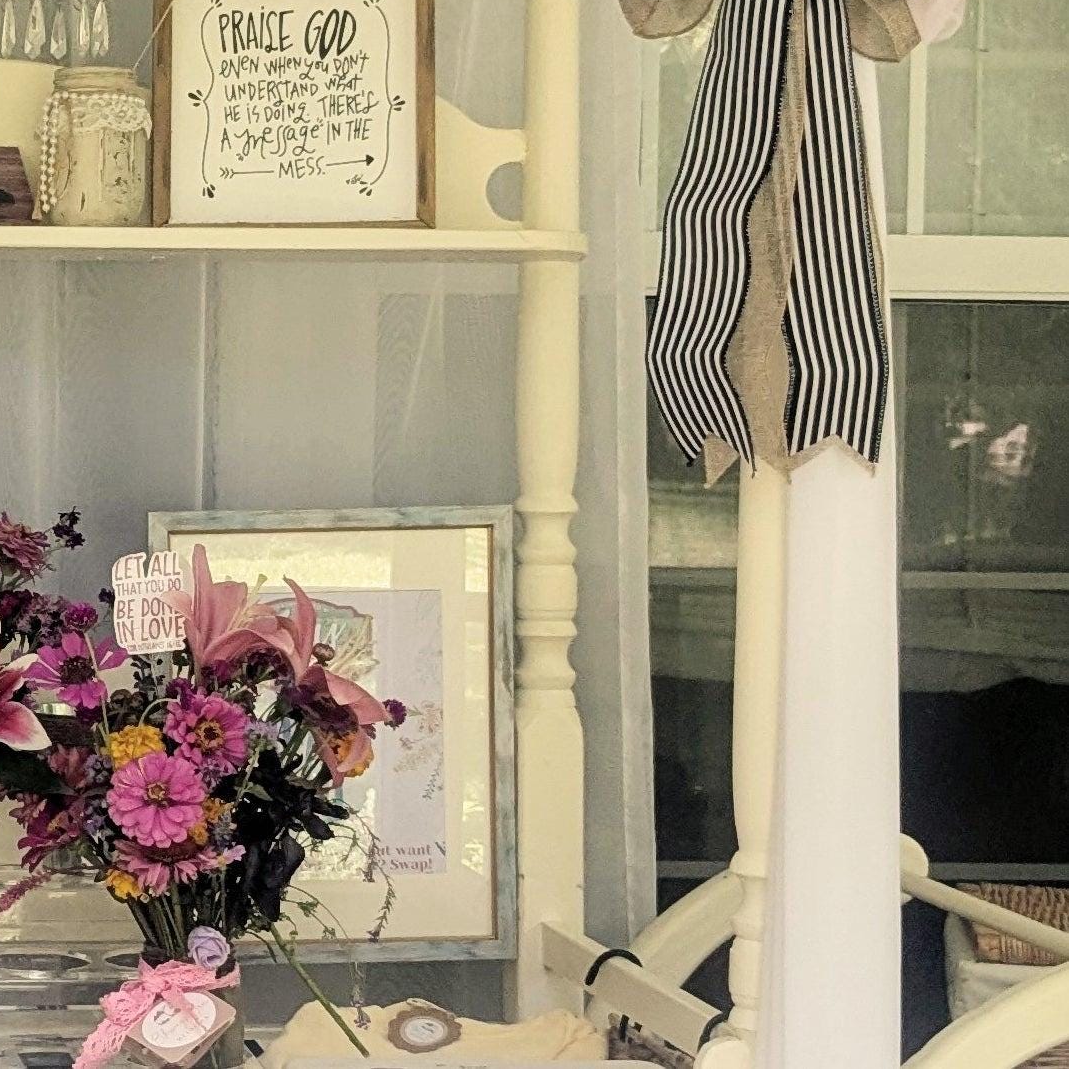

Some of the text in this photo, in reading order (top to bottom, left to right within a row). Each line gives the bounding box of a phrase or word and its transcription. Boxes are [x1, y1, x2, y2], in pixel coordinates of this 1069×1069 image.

[219, 6, 357, 60] PRAISE GOD
[224, 106, 240, 124] HE
[220, 128, 232, 152] A
[327, 120, 341, 145] IN
[346, 118, 373, 142] THE
[278, 155, 326, 179] MESS.
[114, 552, 181, 581] LET ALL
[115, 577, 182, 597] THAT YOU DO
[116, 599, 136, 620] BE
[116, 615, 185, 644] IN LOVE
[395, 844, 432, 856] want
[390, 857, 433, 873] Swap!
